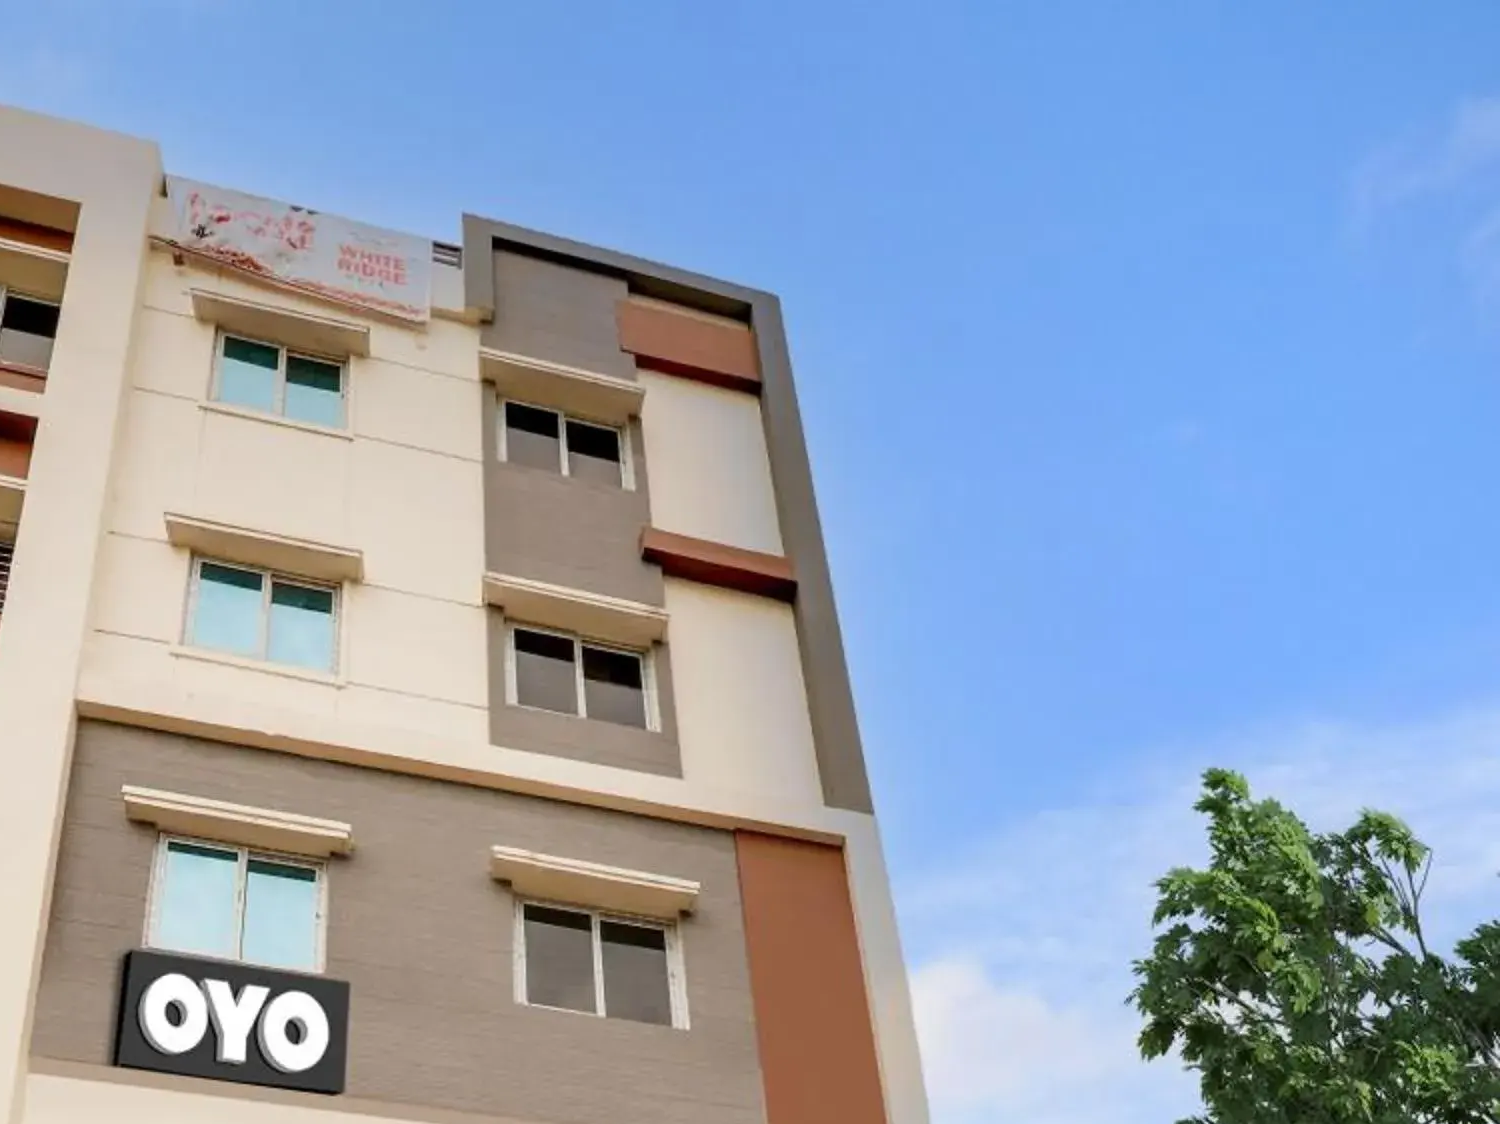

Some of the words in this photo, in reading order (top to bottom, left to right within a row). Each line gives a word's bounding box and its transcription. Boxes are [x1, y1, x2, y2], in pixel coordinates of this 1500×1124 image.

[339, 244, 406, 270] WHITE
[337, 258, 408, 286] RIDGE
[137, 972, 330, 1073] OYO
